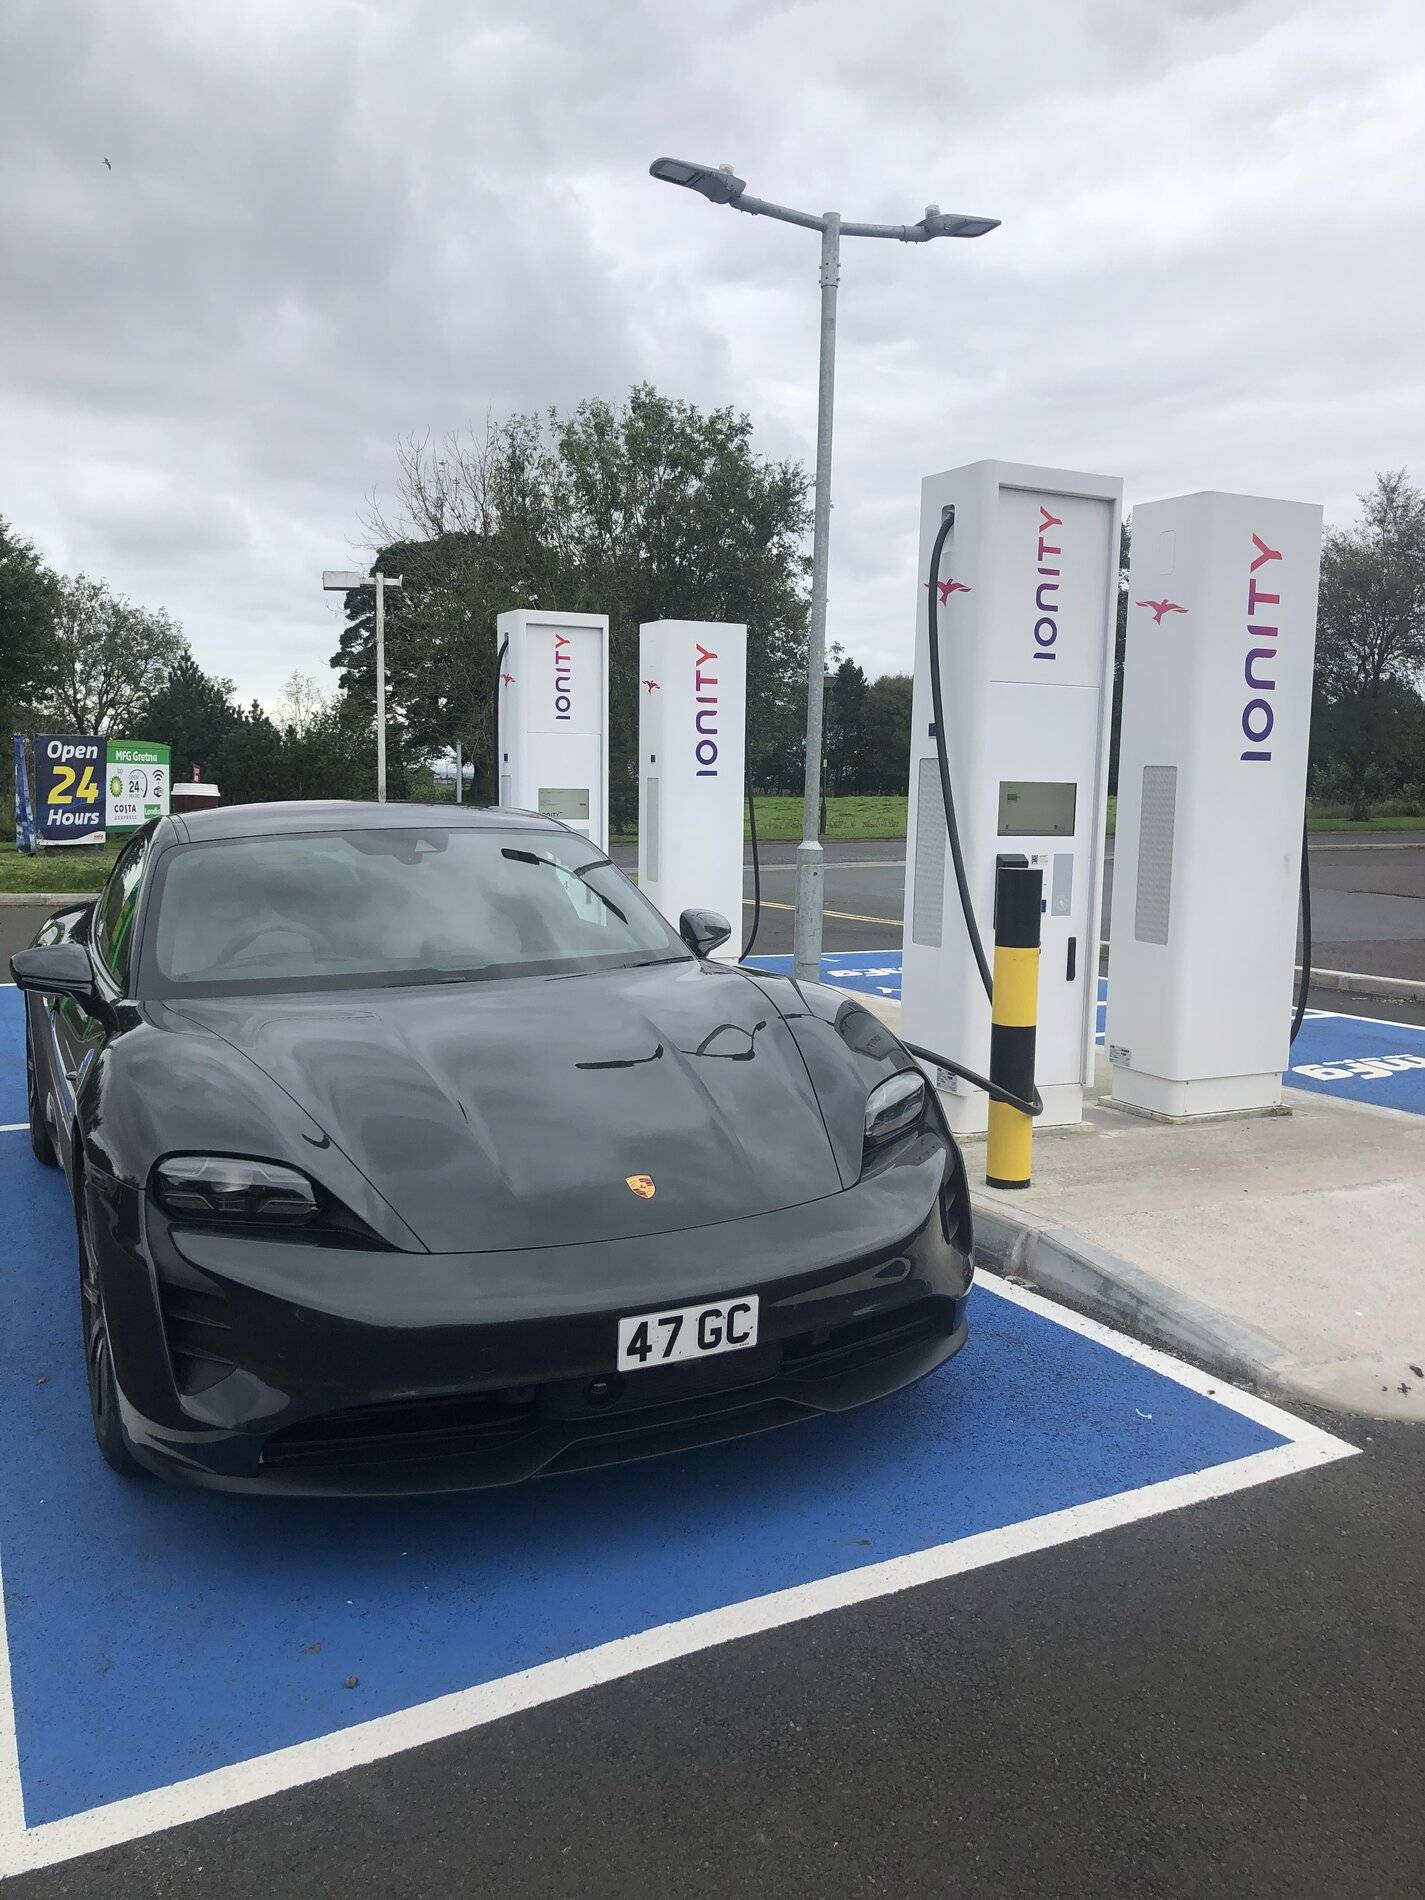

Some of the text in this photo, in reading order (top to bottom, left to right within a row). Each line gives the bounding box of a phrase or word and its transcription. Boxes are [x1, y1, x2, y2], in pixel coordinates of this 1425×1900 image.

[1033, 505, 1063, 660] IONITY
[1240, 532, 1283, 762] IONITY
[555, 633, 571, 720] IONITY
[695, 643, 718, 776] IONITY
[47, 740, 98, 762] Open
[116, 751, 157, 762] MFG Gretna
[47, 765, 99, 805] 24
[129, 780, 139, 793] 24
[47, 809, 99, 826] Hours
[114, 804, 137, 813] COSTA
[626, 1303, 752, 1362] 47 GC
